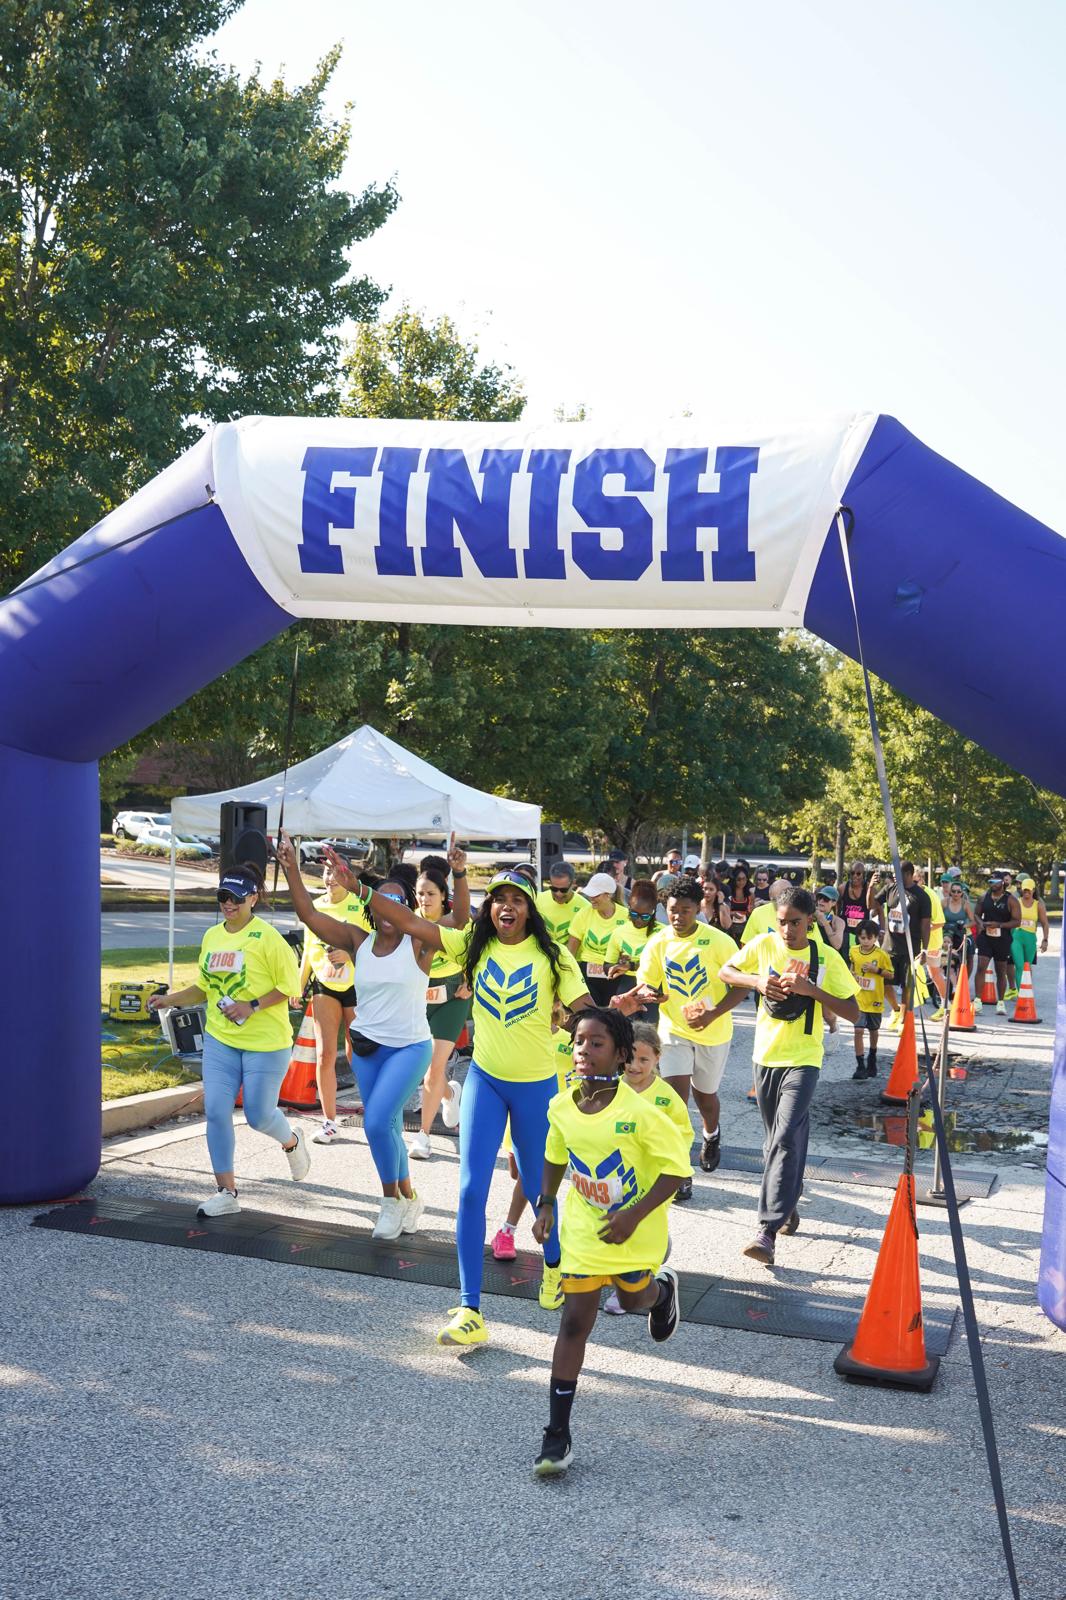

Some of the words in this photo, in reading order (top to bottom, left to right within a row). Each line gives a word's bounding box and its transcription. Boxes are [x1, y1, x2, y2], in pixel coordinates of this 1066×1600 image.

[298, 446, 760, 581] FINISH
[209, 952, 236, 969] 2108
[572, 1173, 611, 1206] 2043
